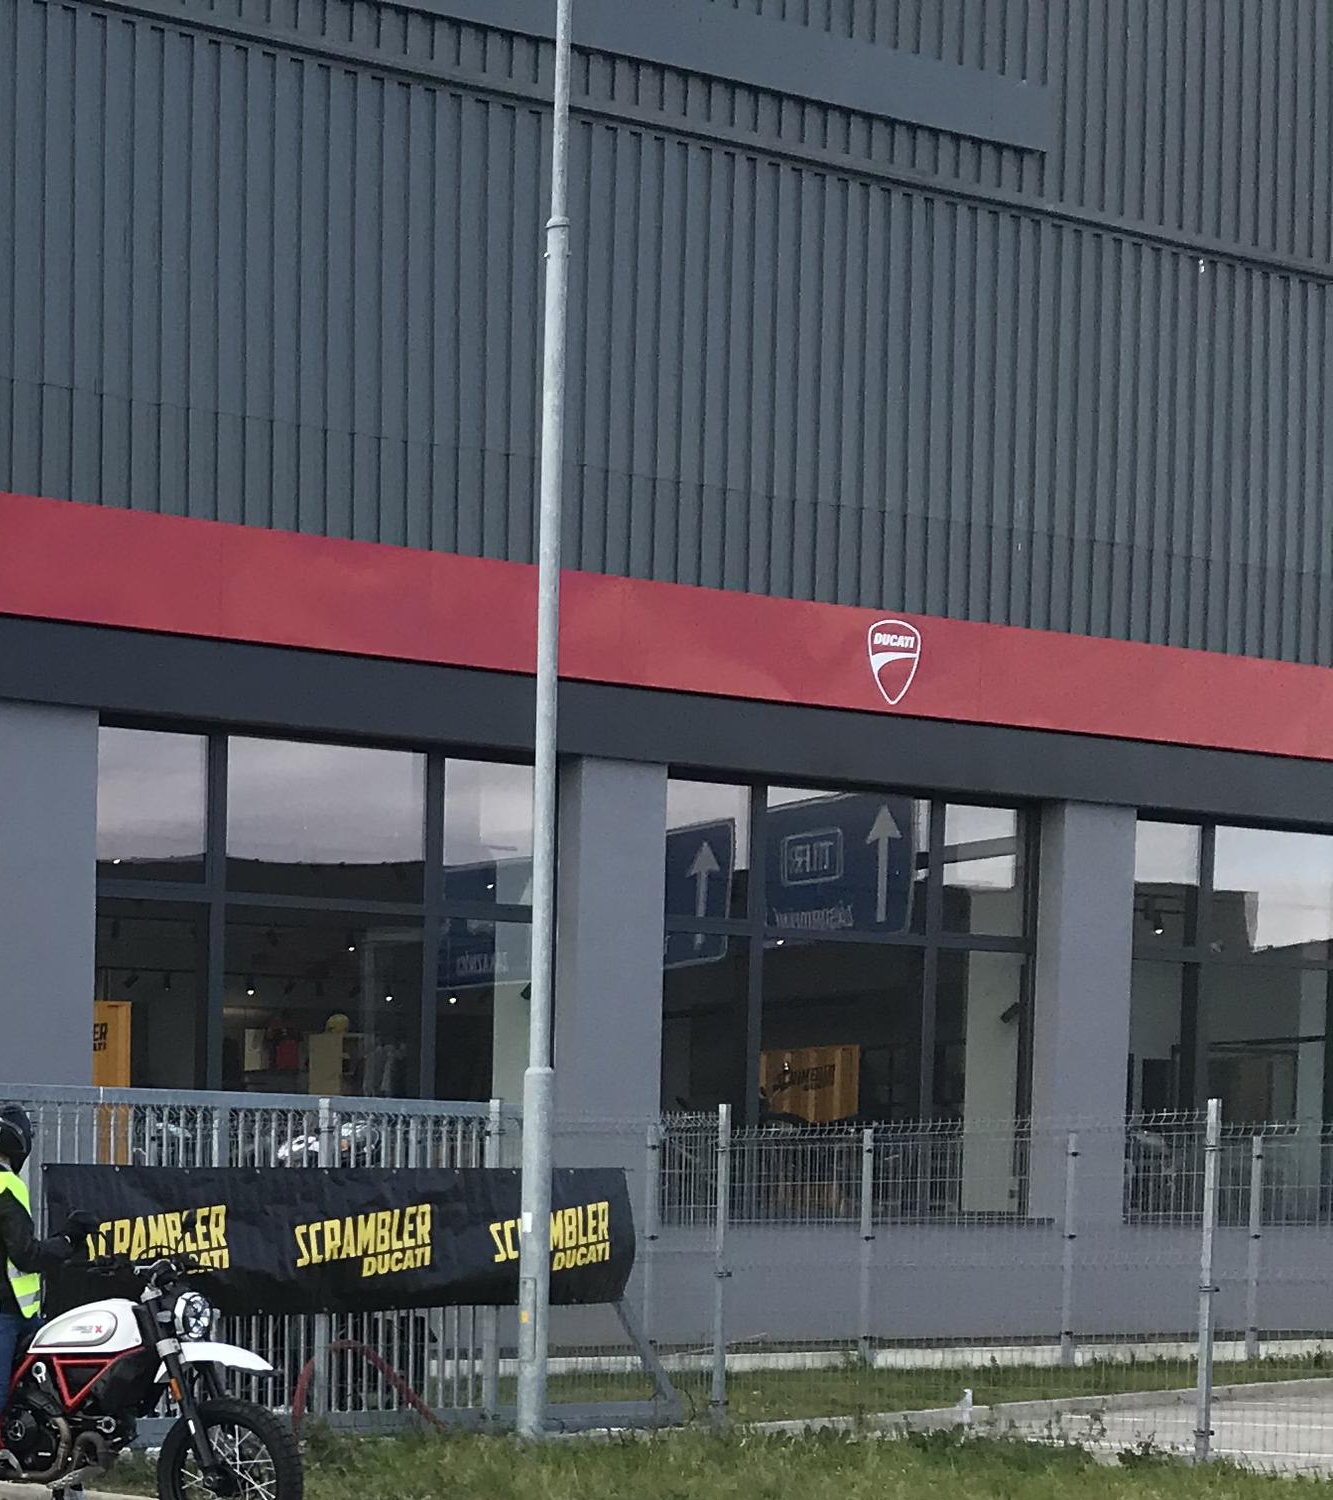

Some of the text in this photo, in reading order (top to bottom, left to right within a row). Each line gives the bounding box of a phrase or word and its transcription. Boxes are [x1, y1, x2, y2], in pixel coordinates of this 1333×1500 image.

[873, 632, 915, 648] DUCATI
[294, 1203, 431, 1268] SCRAMBLER
[489, 1200, 610, 1263] SCMBLER
[362, 1246, 432, 1278] DUCATI
[552, 1241, 611, 1272] DUCATI
